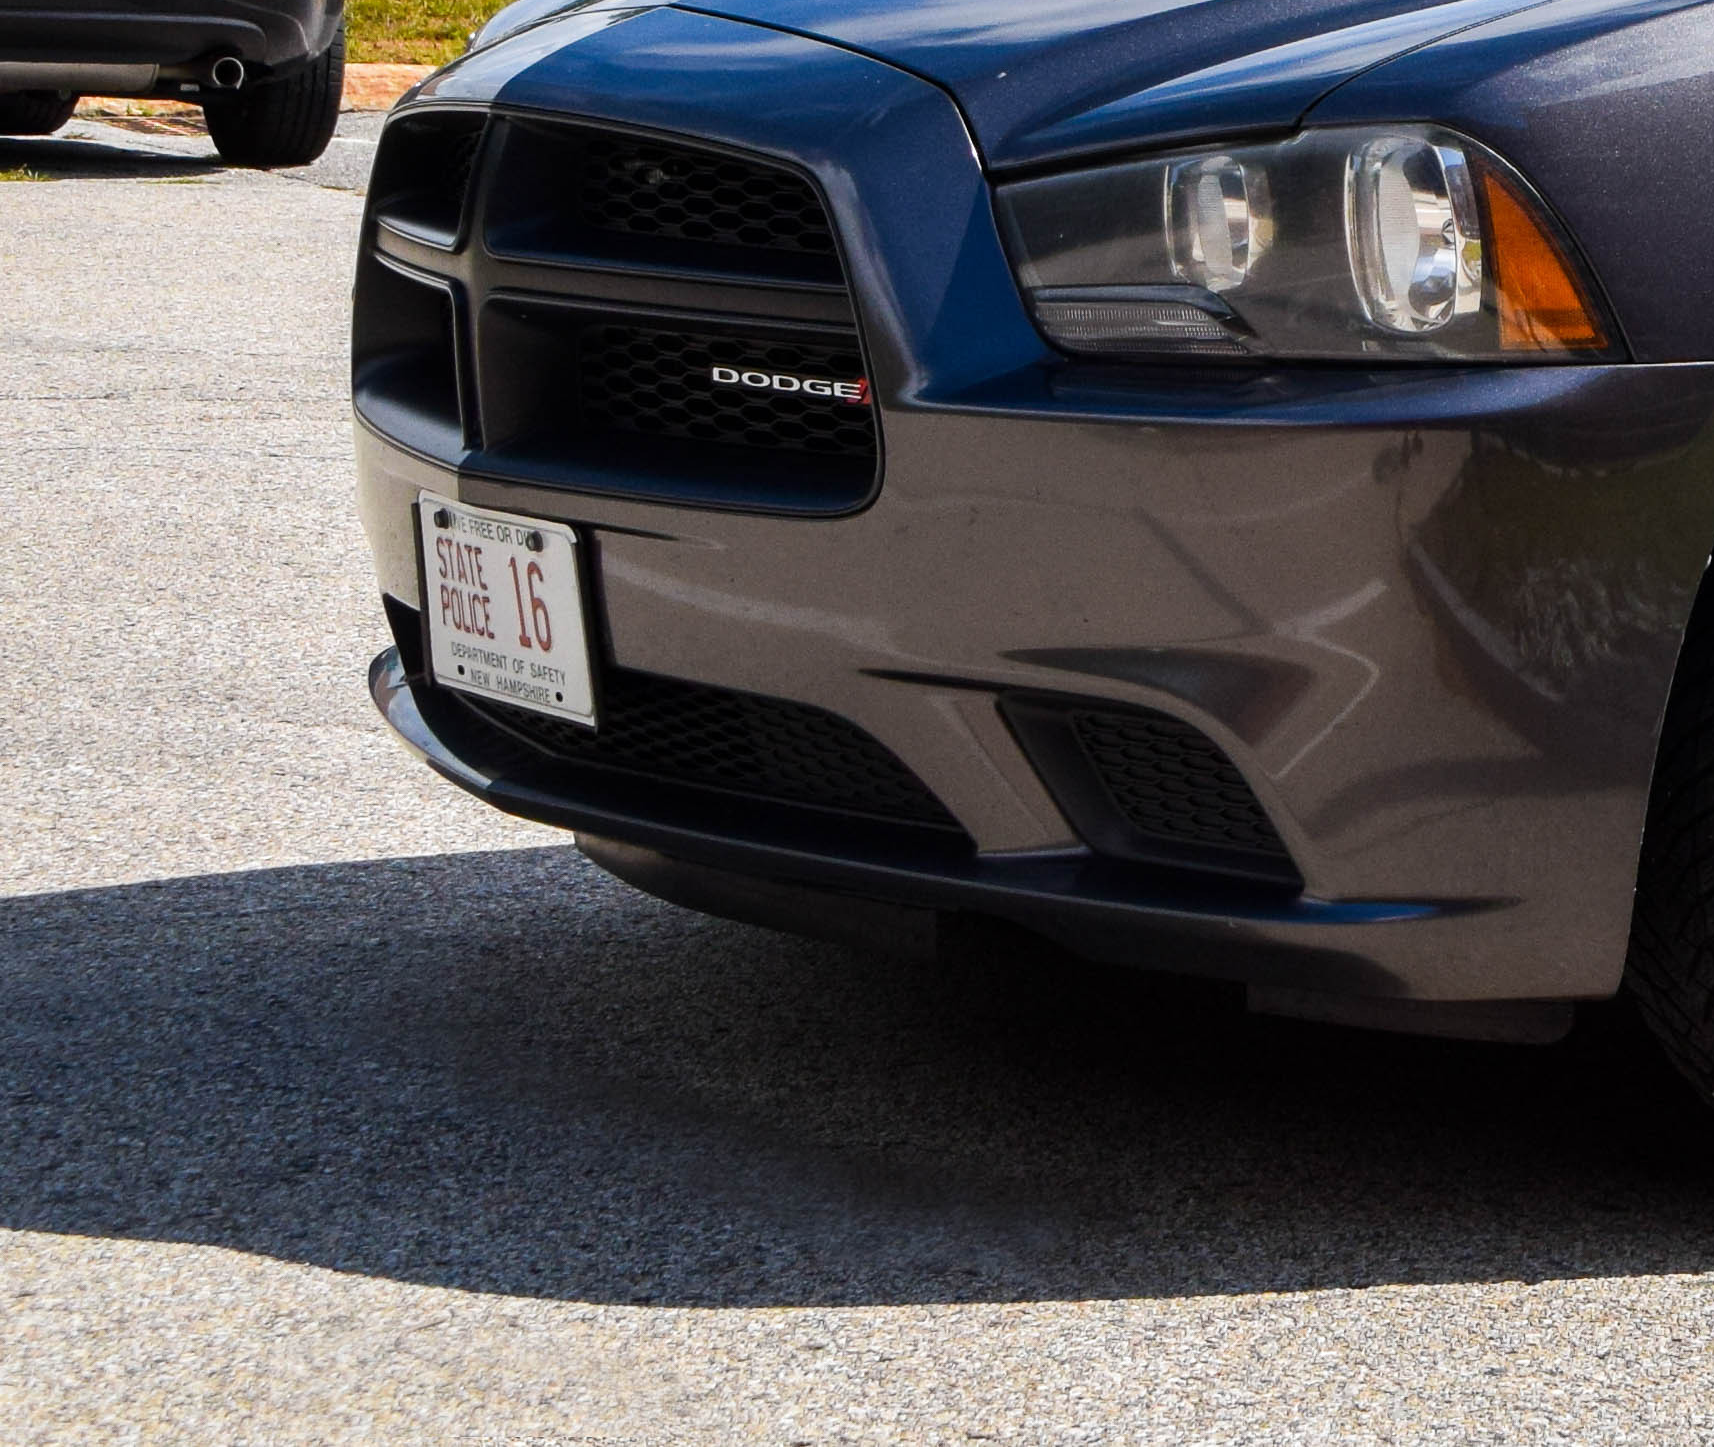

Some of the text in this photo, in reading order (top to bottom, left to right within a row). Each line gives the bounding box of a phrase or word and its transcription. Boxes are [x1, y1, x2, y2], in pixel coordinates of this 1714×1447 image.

[712, 366, 862, 400] DODGE
[468, 517, 495, 541] FREE
[496, 524, 513, 545] OR
[435, 536, 488, 591] STATE
[440, 584, 495, 640] POLICE
[507, 555, 553, 653] 16
[451, 641, 567, 687] DEPARTMENT OF SAFETY
[470, 668, 551, 704] NEW HAMPSHIRE
